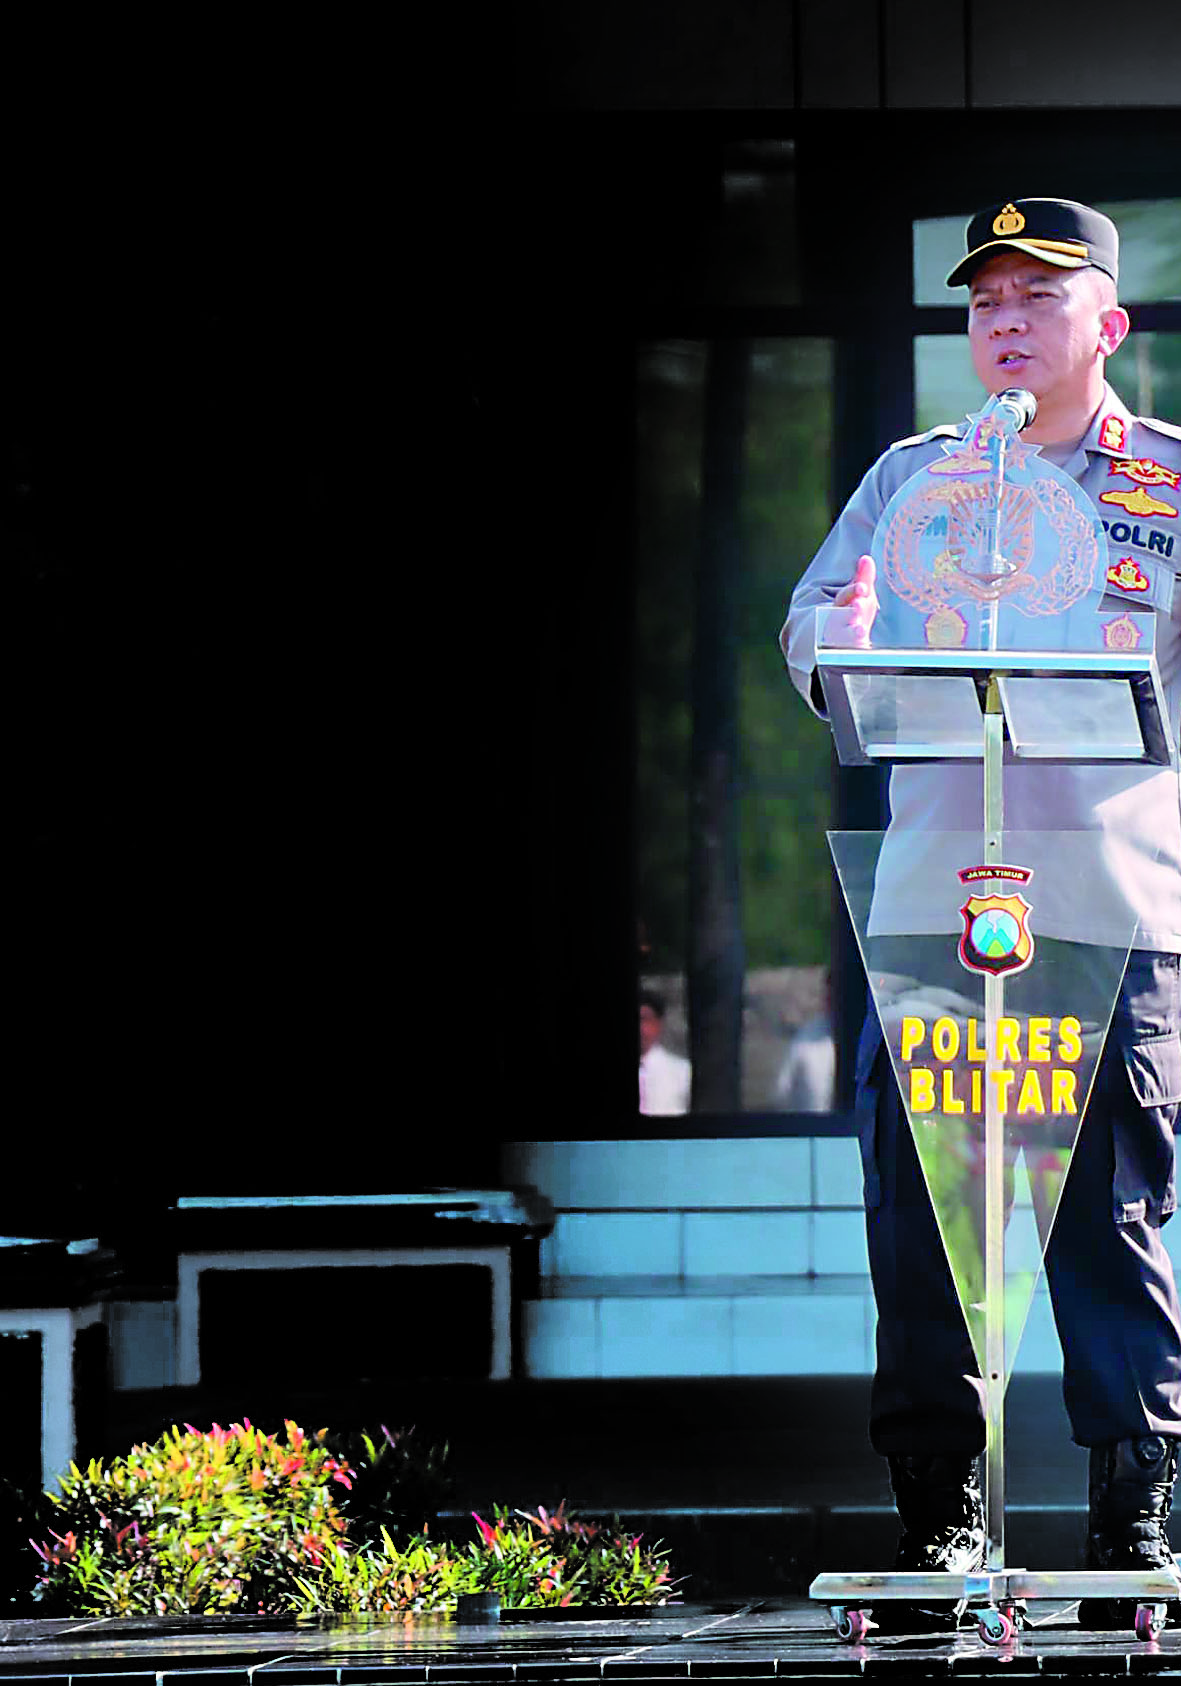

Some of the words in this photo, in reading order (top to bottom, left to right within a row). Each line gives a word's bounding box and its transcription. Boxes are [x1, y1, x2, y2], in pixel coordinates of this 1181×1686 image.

[966, 870, 993, 879] JAWA
[994, 870, 1024, 879] TIMUR
[900, 1016, 1083, 1063] POLRES
[909, 1067, 1078, 1115] BLITAR
